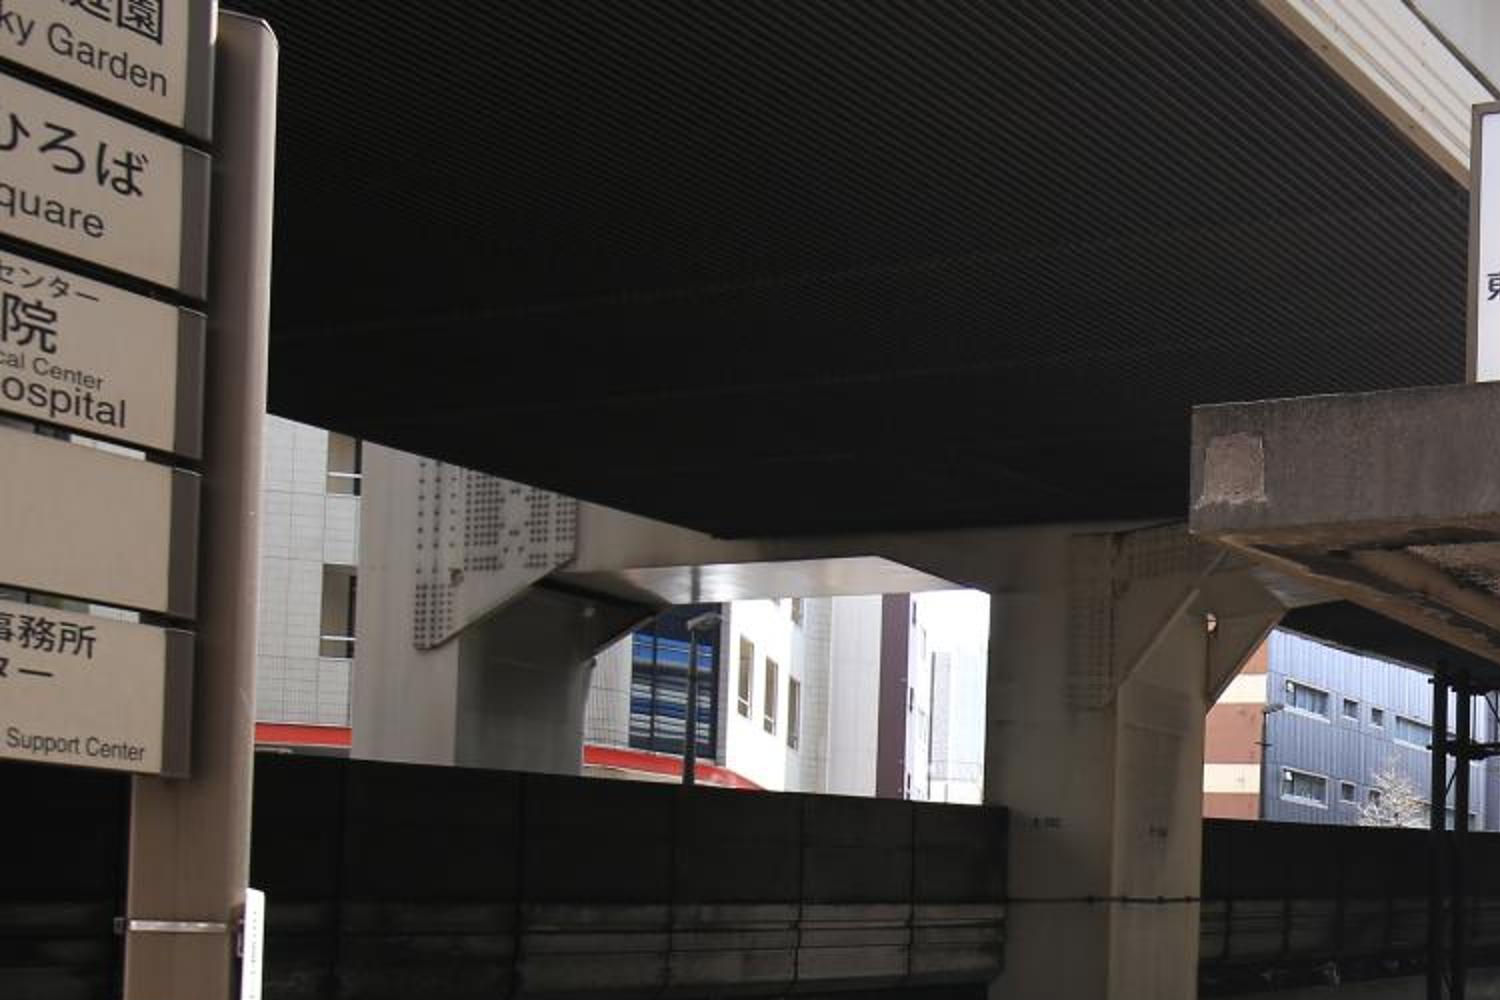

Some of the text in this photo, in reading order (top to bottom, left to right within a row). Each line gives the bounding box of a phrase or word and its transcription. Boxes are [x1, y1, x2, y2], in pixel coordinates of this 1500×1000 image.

[47, 22, 167, 97] Garden
[2, 292, 58, 354] 院
[33, 357, 104, 391] Center
[2, 375, 126, 428] ospital
[6, 726, 144, 761] Support Center
